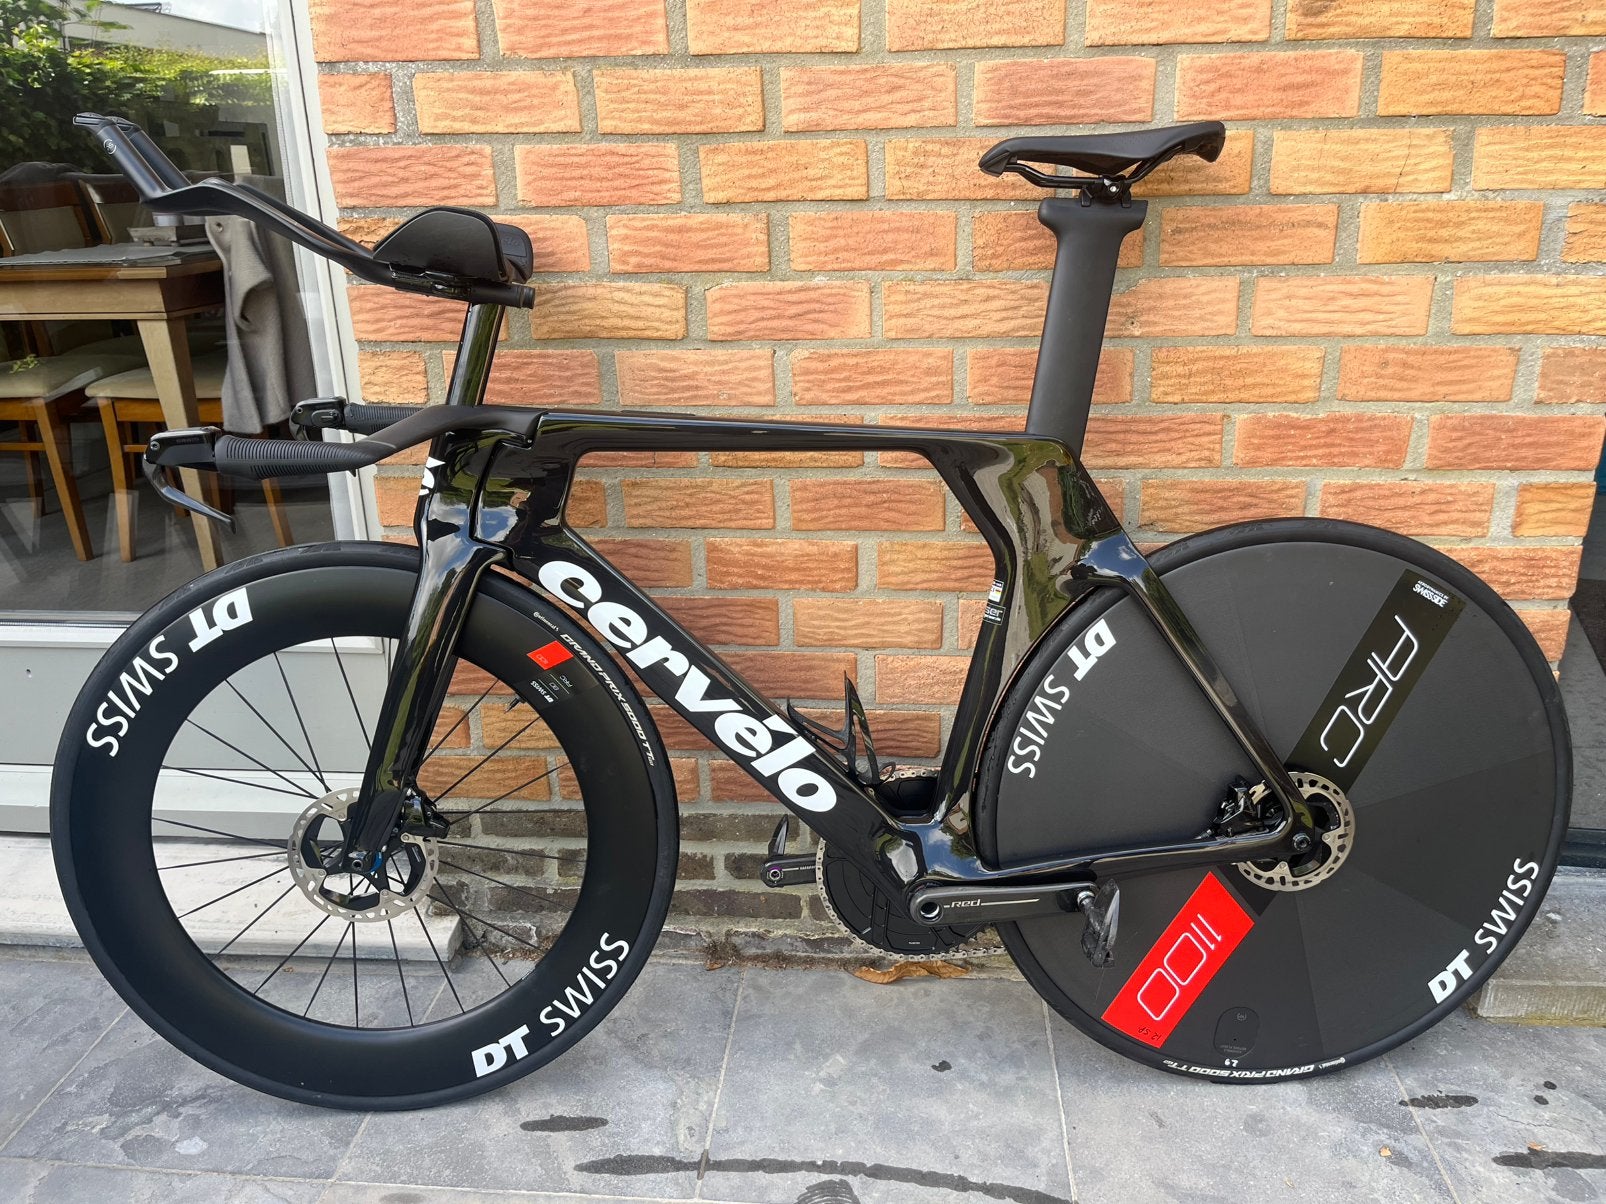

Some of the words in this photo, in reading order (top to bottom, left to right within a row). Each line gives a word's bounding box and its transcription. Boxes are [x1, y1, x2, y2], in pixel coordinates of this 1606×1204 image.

[188, 587, 254, 653] DT
[1064, 612, 1117, 681] DT
[86, 634, 180, 758] SWISS
[530, 680, 547, 696] SWISS
[543, 694, 554, 703] DT
[560, 633, 603, 673] GRAND
[599, 671, 626, 702] PRIX
[621, 702, 647, 740] 5000
[1007, 674, 1070, 779] SWISS
[1320, 614, 1419, 768] ARC
[1137, 913, 1222, 1021] 1100
[1428, 949, 1474, 1003] DT
[1474, 858, 1539, 955] SWISS
[472, 1025, 530, 1078] DT
[539, 932, 630, 1037] SWISS
[1189, 1065, 1230, 1077] 5000
[1231, 1069, 1267, 1078] PRIX
[1266, 1064, 1315, 1077] GRAND
